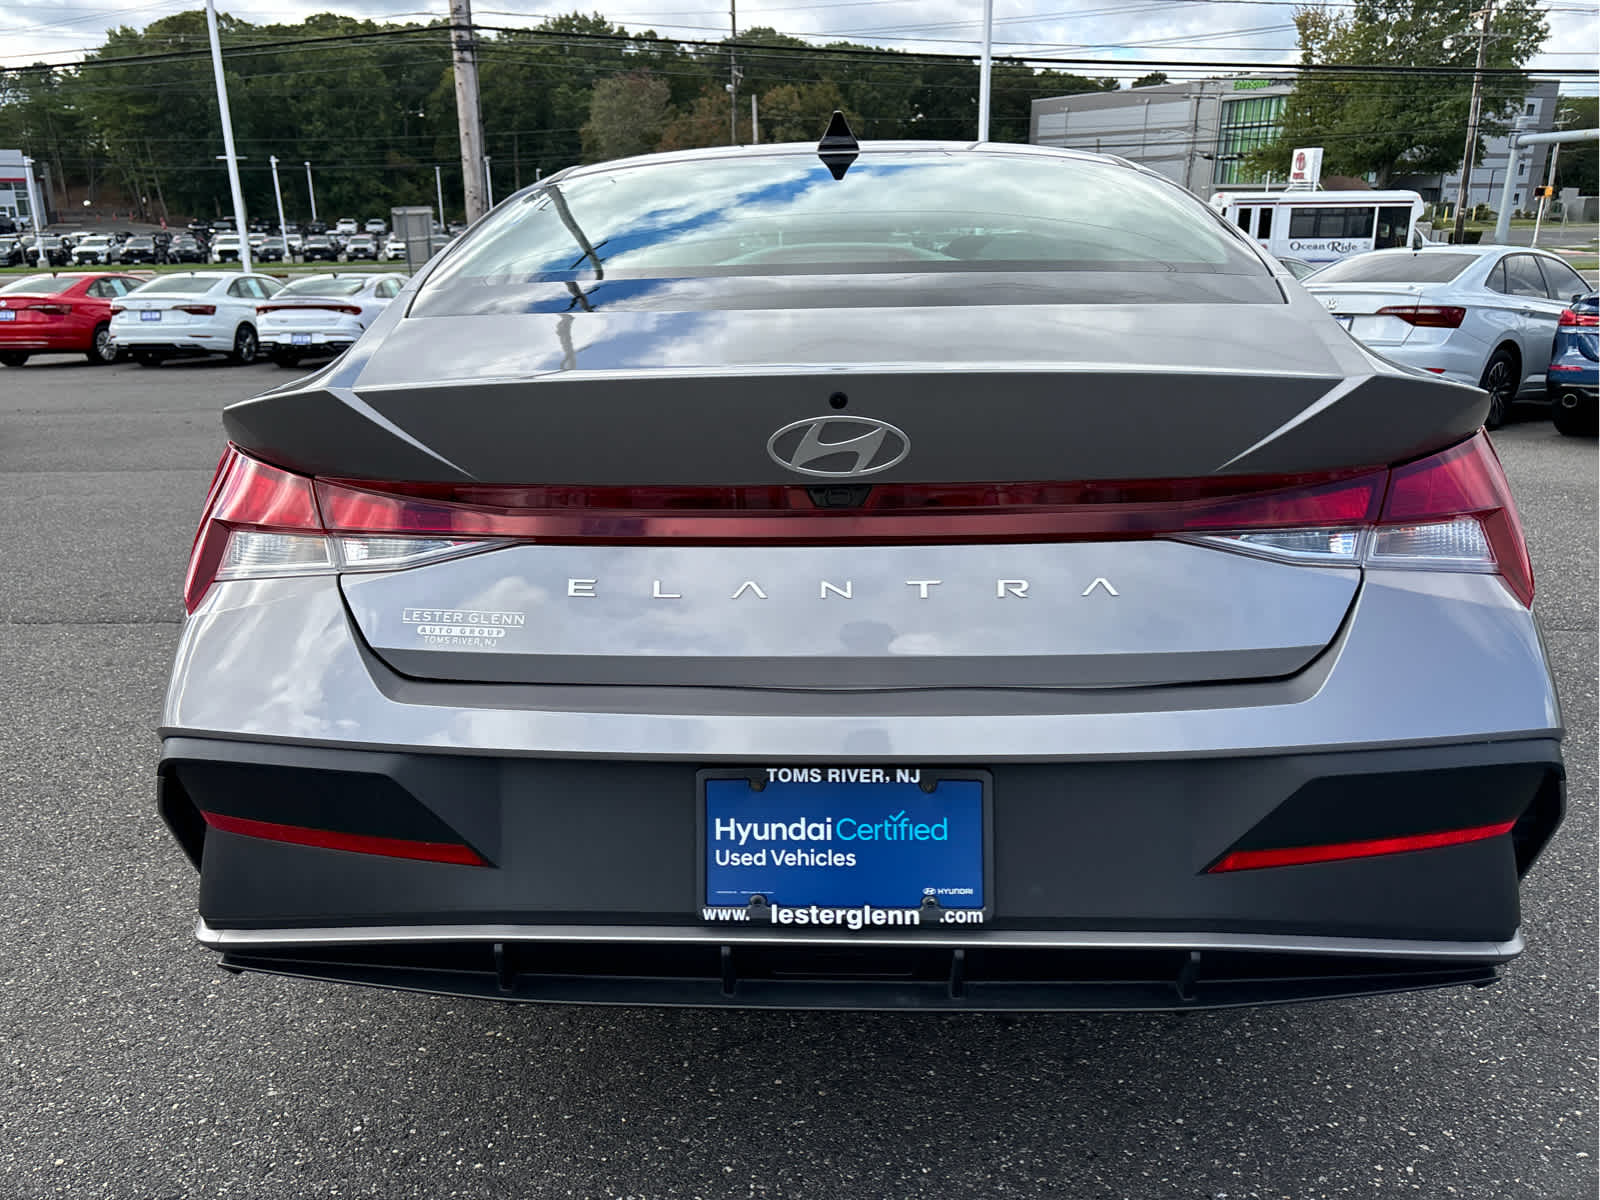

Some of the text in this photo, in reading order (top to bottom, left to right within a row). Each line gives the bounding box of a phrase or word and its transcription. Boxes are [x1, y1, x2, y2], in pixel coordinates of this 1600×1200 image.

[1290, 241, 1325, 251] Ocean
[1327, 241, 1357, 253] Ride
[567, 577, 1120, 600] ELANTRA
[402, 609, 525, 625] LESTER GLENN
[420, 626, 503, 637] AUTO GROUP
[423, 635, 450, 645] TOMS
[484, 639, 497, 647] NJ
[767, 768, 921, 784] TOMS RIVER, NJ
[715, 811, 948, 845] Hyundai Certified
[715, 849, 856, 867] Used Vehicles
[702, 904, 984, 930] www. lesterglenn .com
